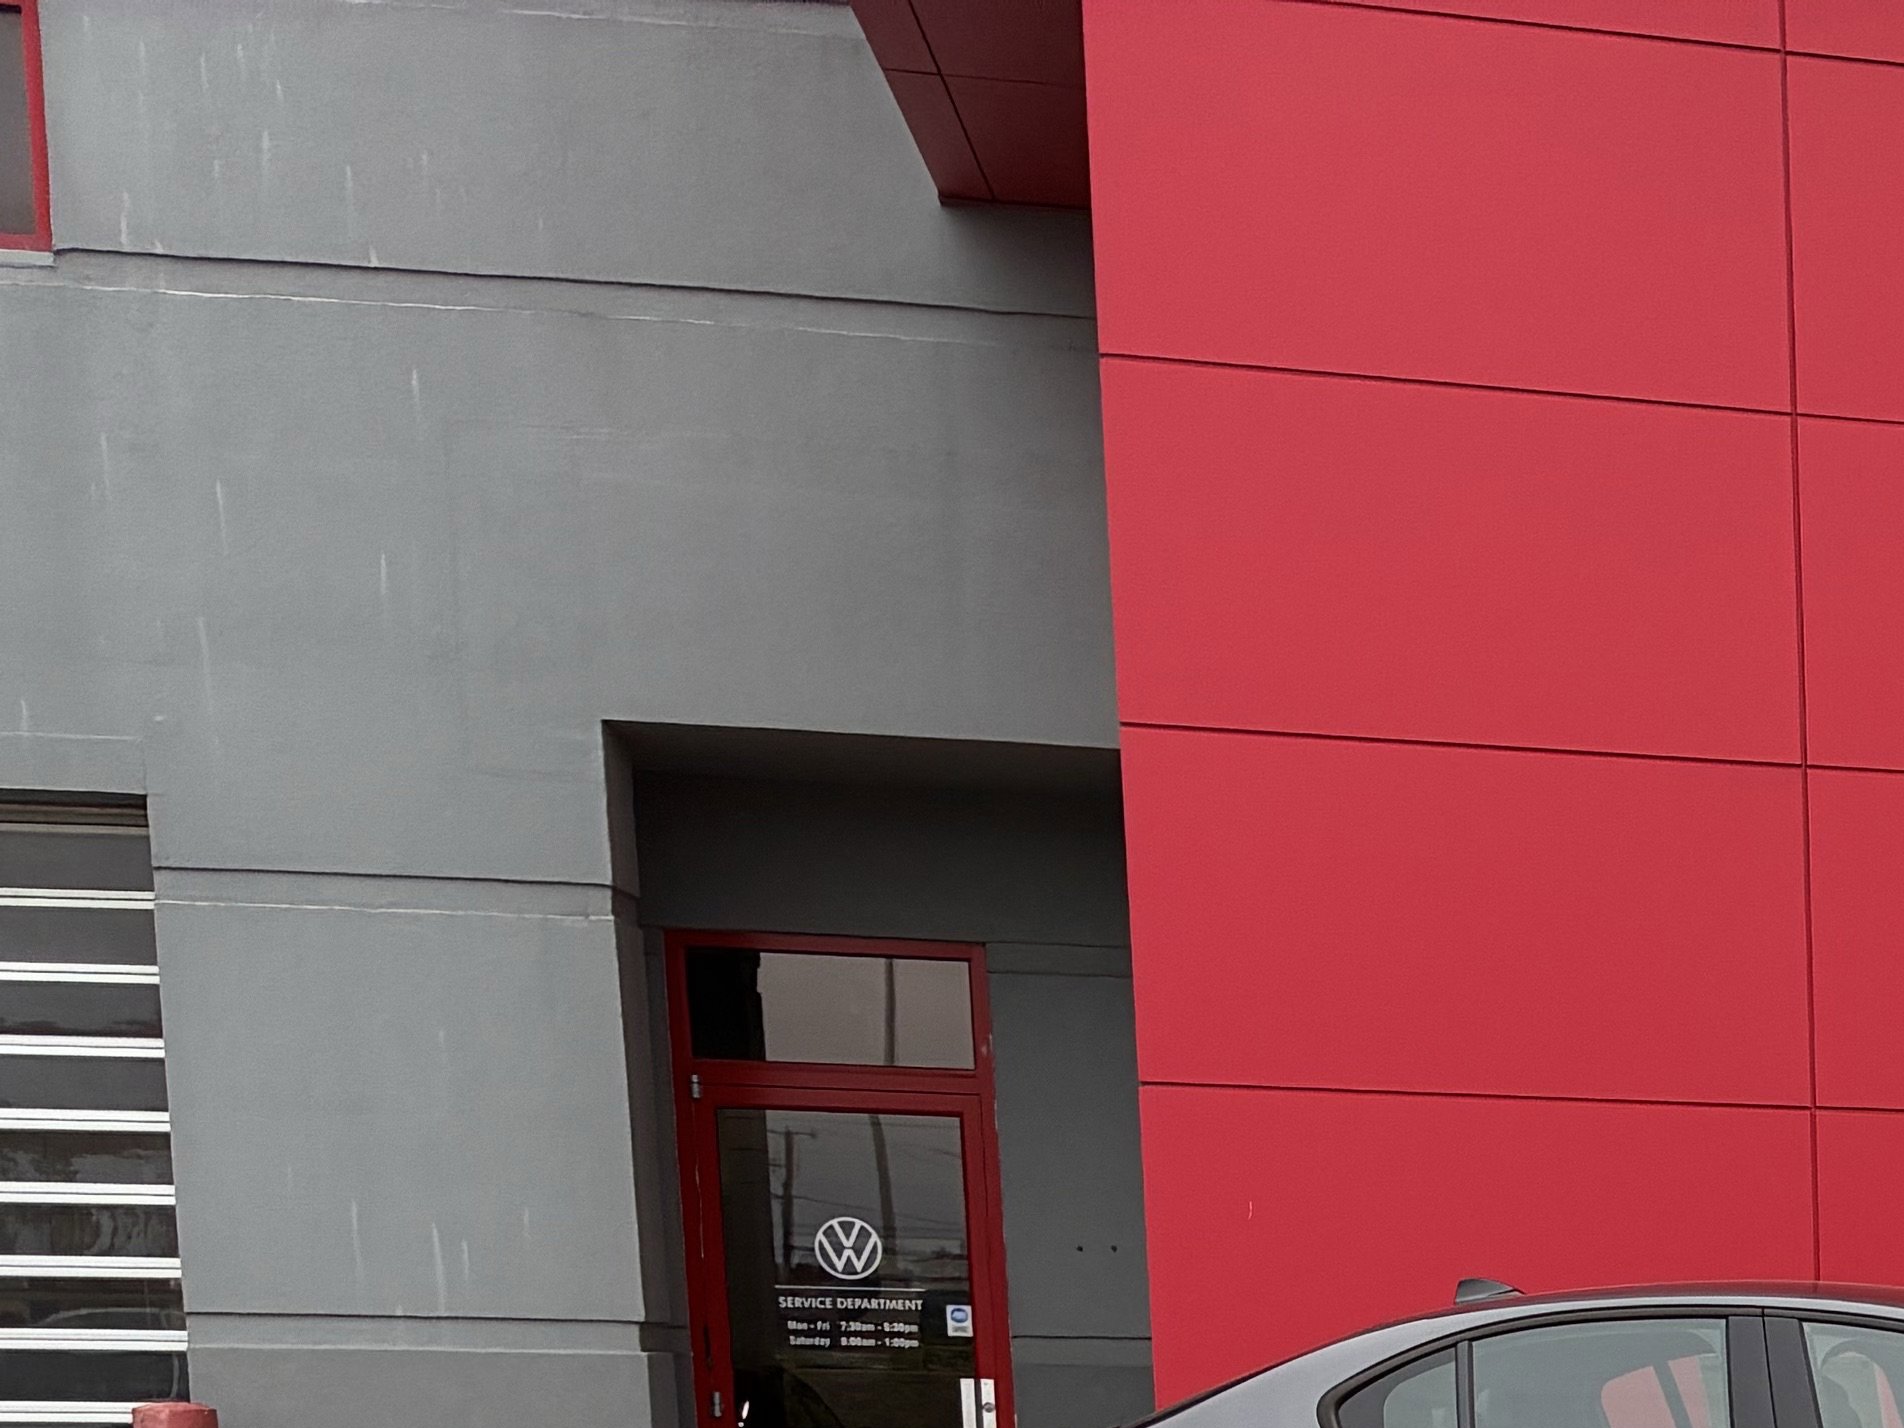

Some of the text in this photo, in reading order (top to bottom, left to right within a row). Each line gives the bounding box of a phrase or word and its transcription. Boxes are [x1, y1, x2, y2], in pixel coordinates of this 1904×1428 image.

[779, 1296, 923, 1310] SERVICE DEPARTMENT
[789, 1336, 831, 1348] Saturday
